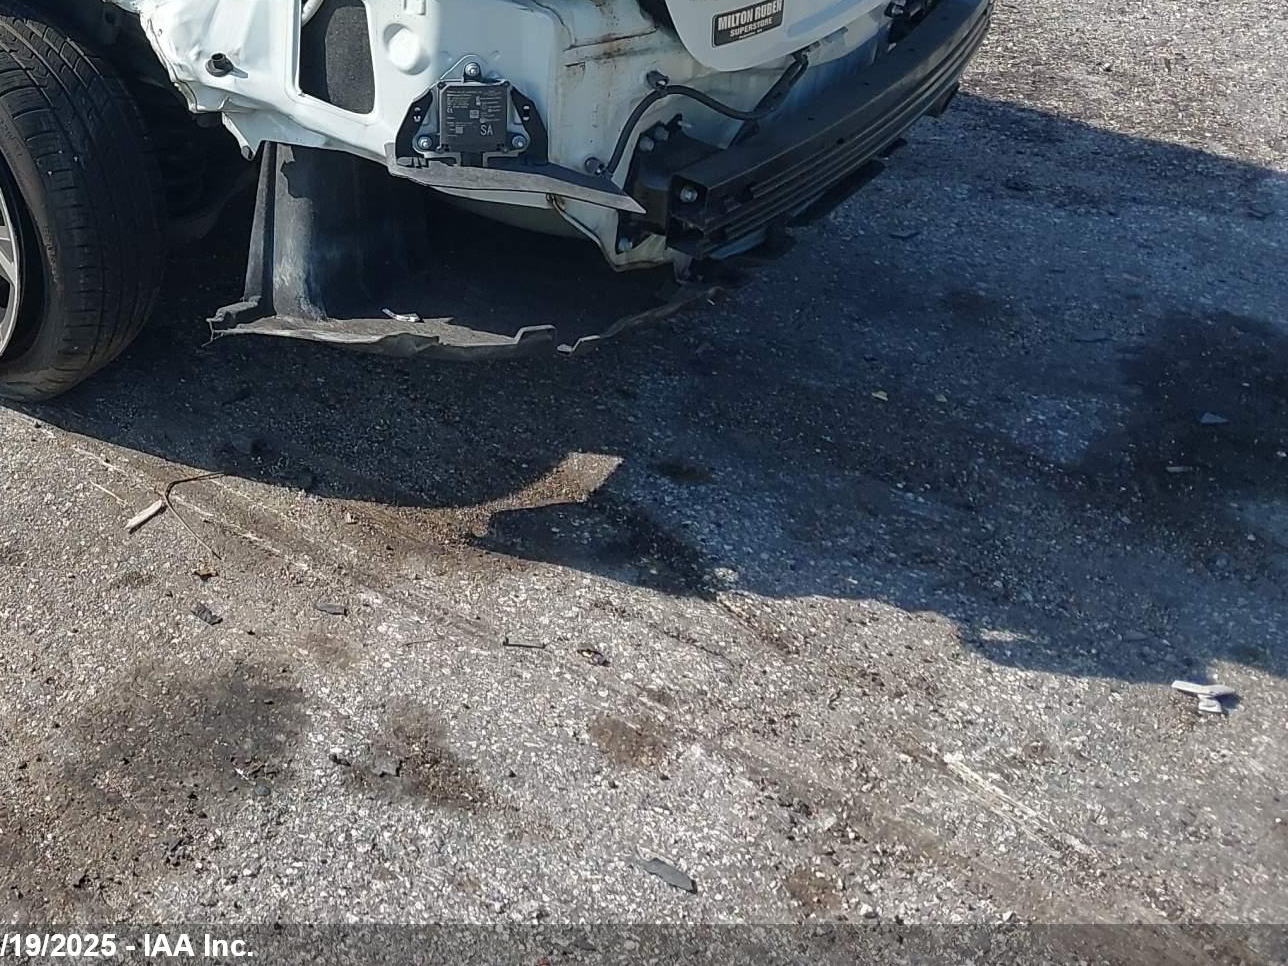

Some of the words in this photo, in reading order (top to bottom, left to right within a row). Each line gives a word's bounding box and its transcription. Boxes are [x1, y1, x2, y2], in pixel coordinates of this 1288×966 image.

[717, 8, 754, 31] MILTON
[729, 16, 774, 38] SUPERSTORE
[480, 124, 494, 136] SA
